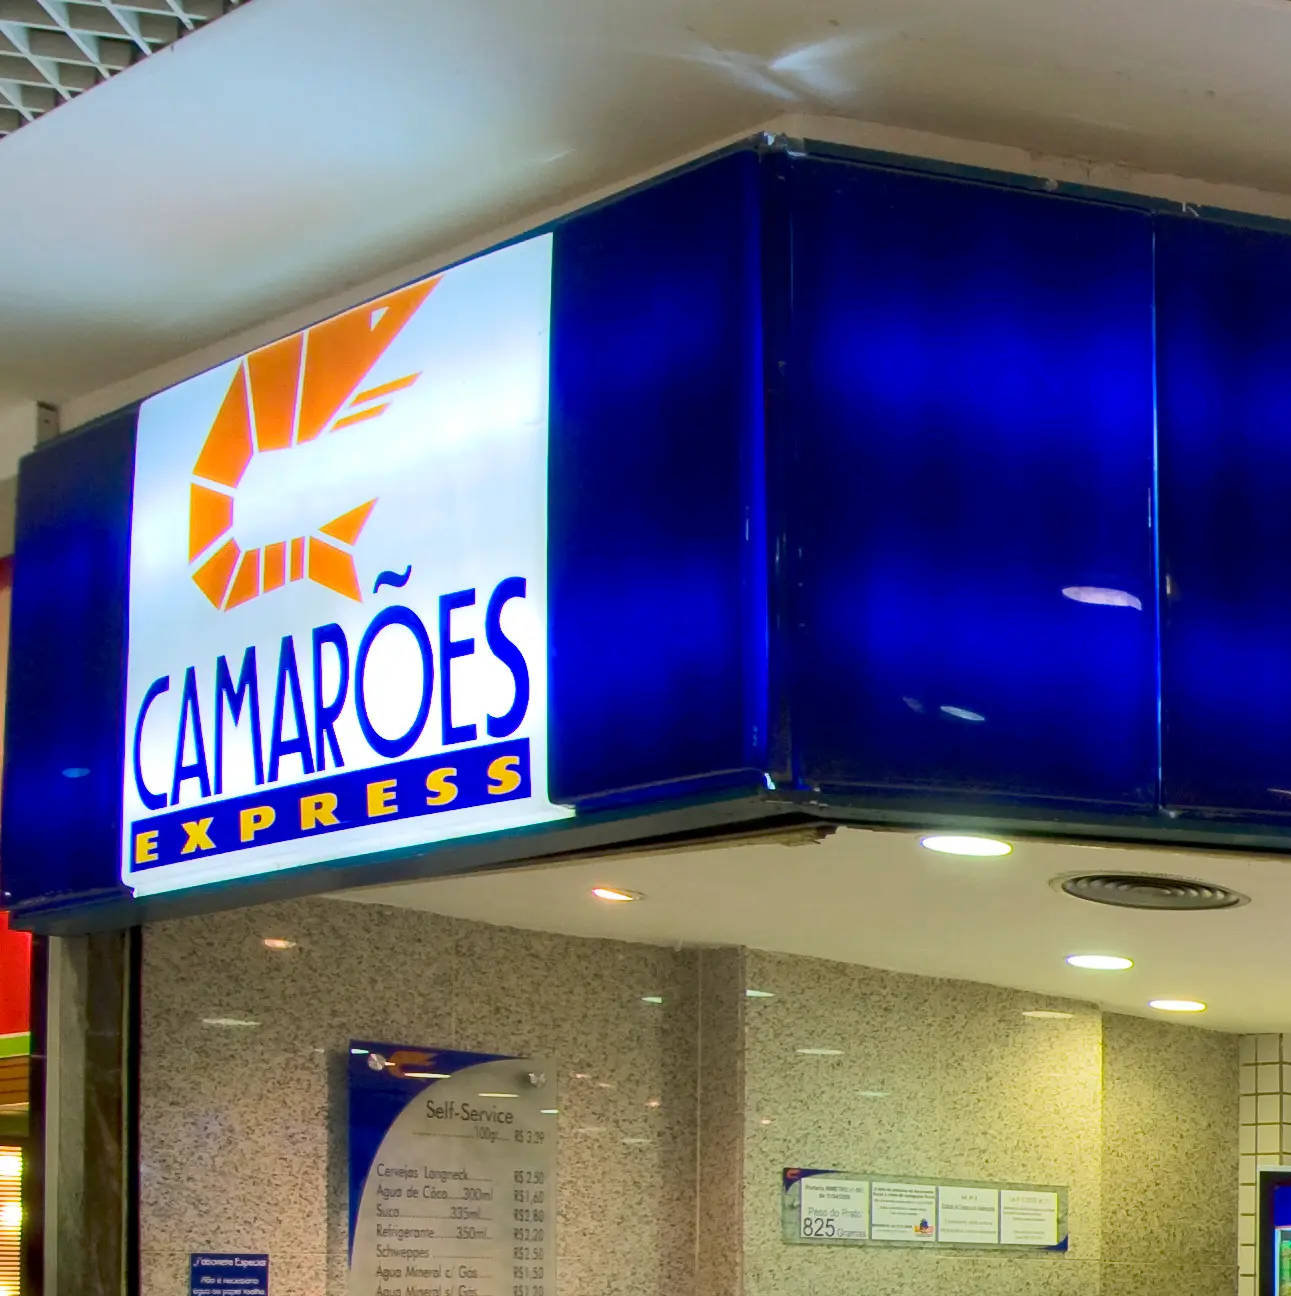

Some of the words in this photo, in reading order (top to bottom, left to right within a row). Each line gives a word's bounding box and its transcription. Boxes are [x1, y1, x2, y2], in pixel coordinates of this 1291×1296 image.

[133, 565, 530, 811] CAMARÕES
[135, 755, 522, 865] EXPRESS
[426, 1100, 514, 1124] Self-Service
[377, 1223, 435, 1241] Refrigerante
[803, 1217, 836, 1238] 825
[377, 1244, 430, 1261] Schweppes
